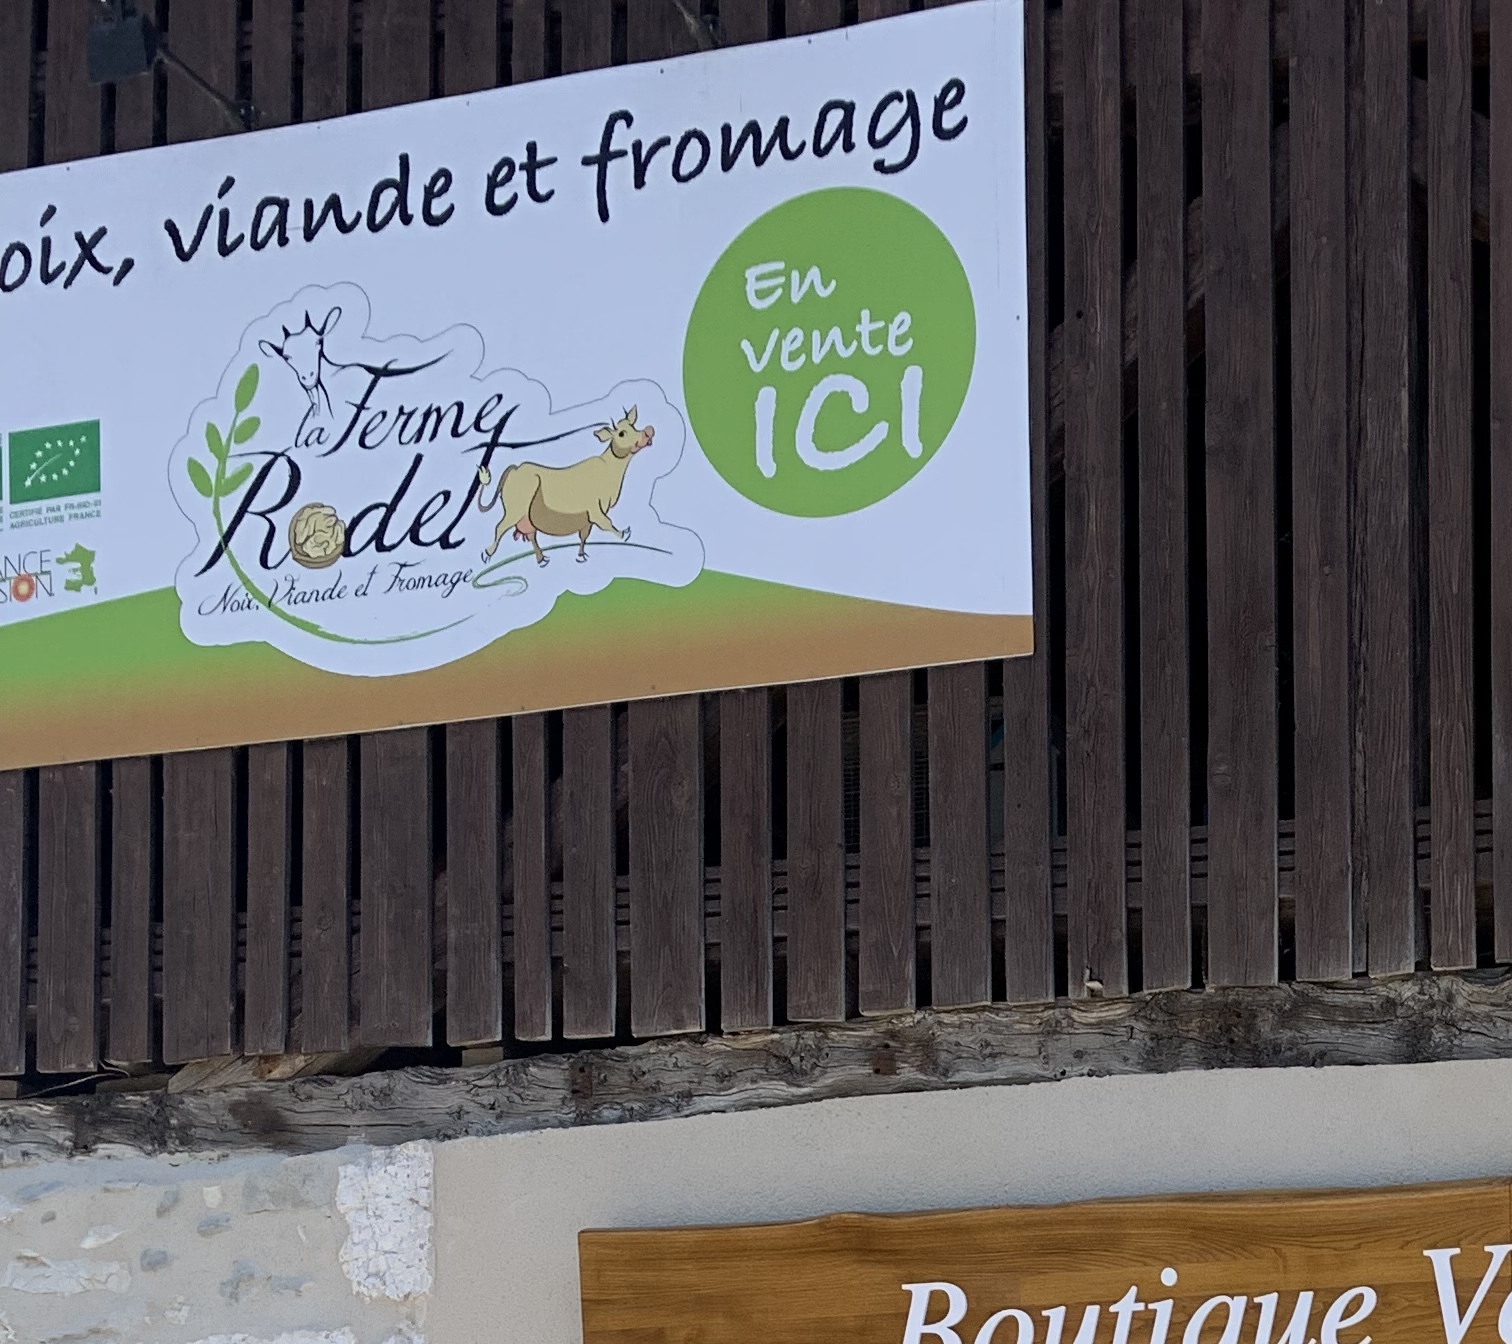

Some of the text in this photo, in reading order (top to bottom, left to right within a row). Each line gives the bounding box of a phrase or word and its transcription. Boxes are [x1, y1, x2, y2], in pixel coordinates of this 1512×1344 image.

[164, 154, 455, 262] viande
[485, 140, 558, 216] et
[581, 77, 969, 222] fromage
[745, 260, 836, 310] En
[741, 308, 914, 373] vente
[294, 402, 330, 448] la
[754, 365, 924, 478] ICI
[9, 509, 101, 529] AGRICULTURE FRANCE
[268, 570, 348, 608] Viande
[385, 559, 473, 599] Fromage
